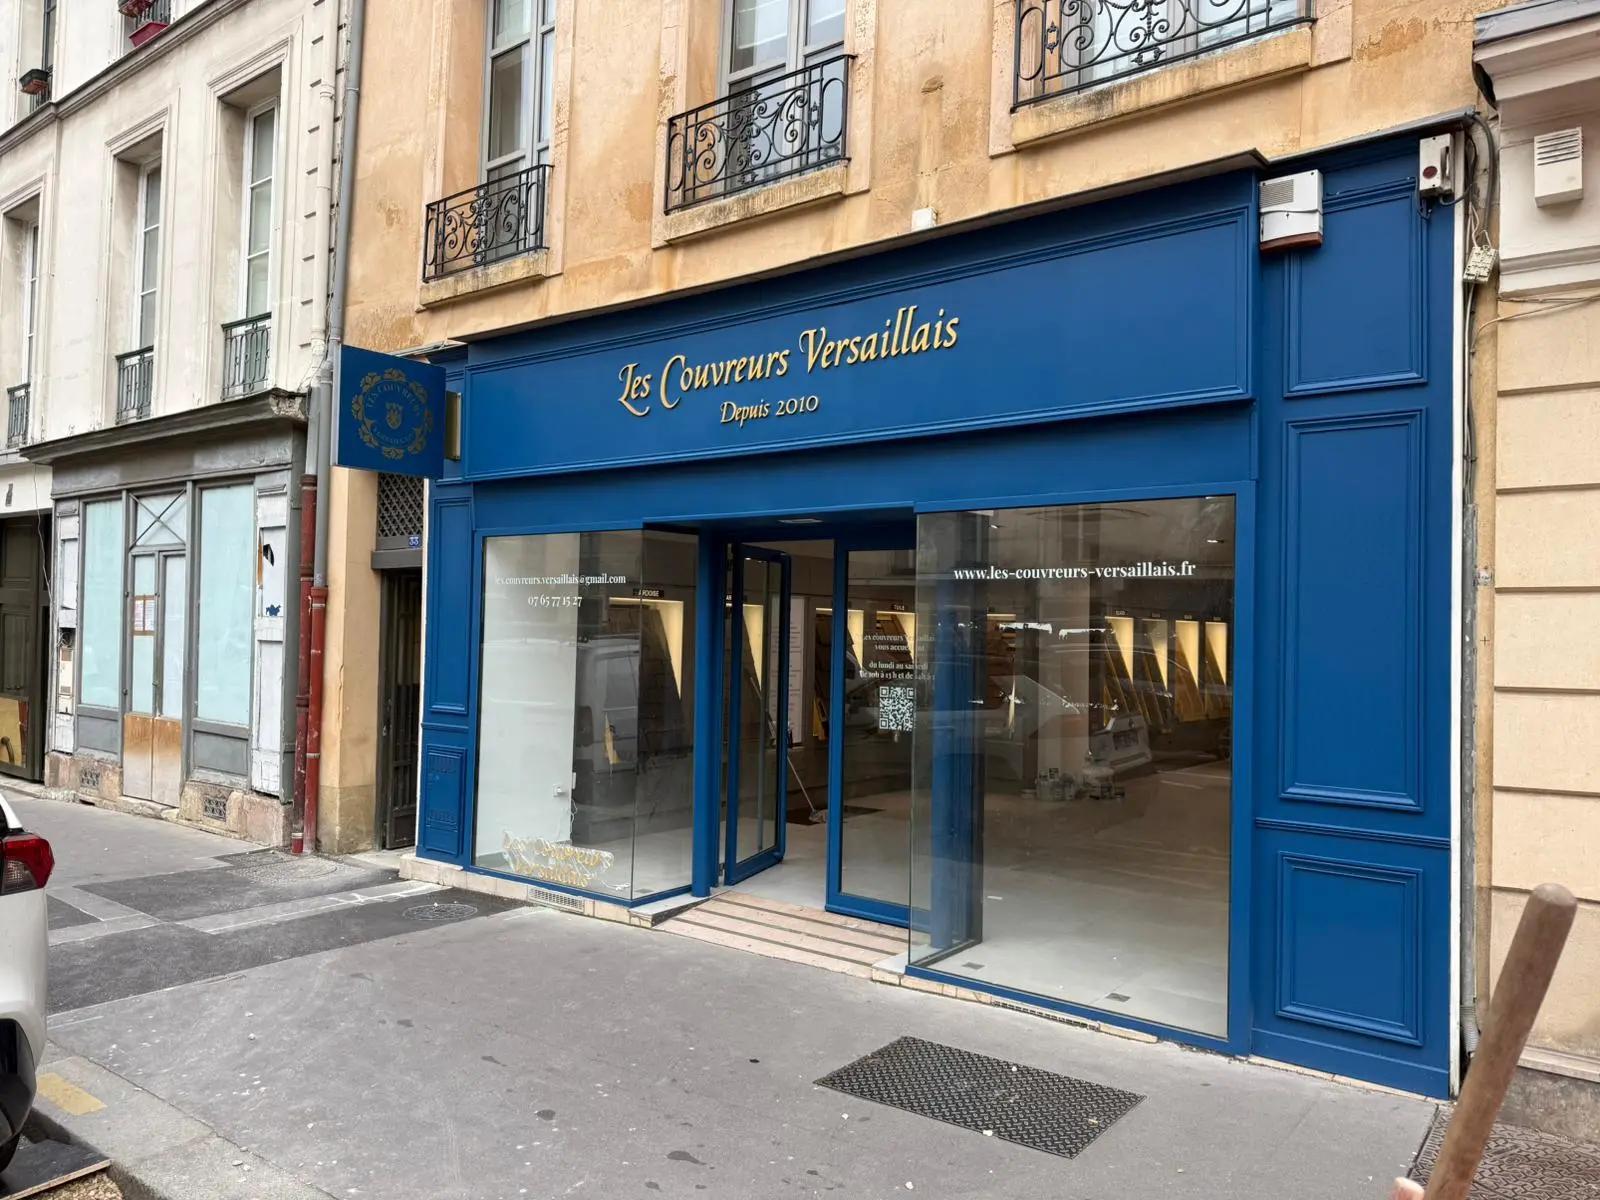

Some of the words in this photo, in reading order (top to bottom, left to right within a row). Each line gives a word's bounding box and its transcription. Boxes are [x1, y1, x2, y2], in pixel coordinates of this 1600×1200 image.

[617, 362, 653, 417] Les
[659, 348, 791, 410] Couvreurs
[799, 305, 960, 374] Versaillais
[720, 399, 770, 428] Depuis
[775, 395, 820, 416] 2010
[953, 560, 1197, 580] www.les-couvreurs-versaillais.fr
[527, 595, 538, 608] 07
[551, 596, 561, 608] 77
[572, 595, 583, 608] 27
[878, 661, 895, 669] lundi
